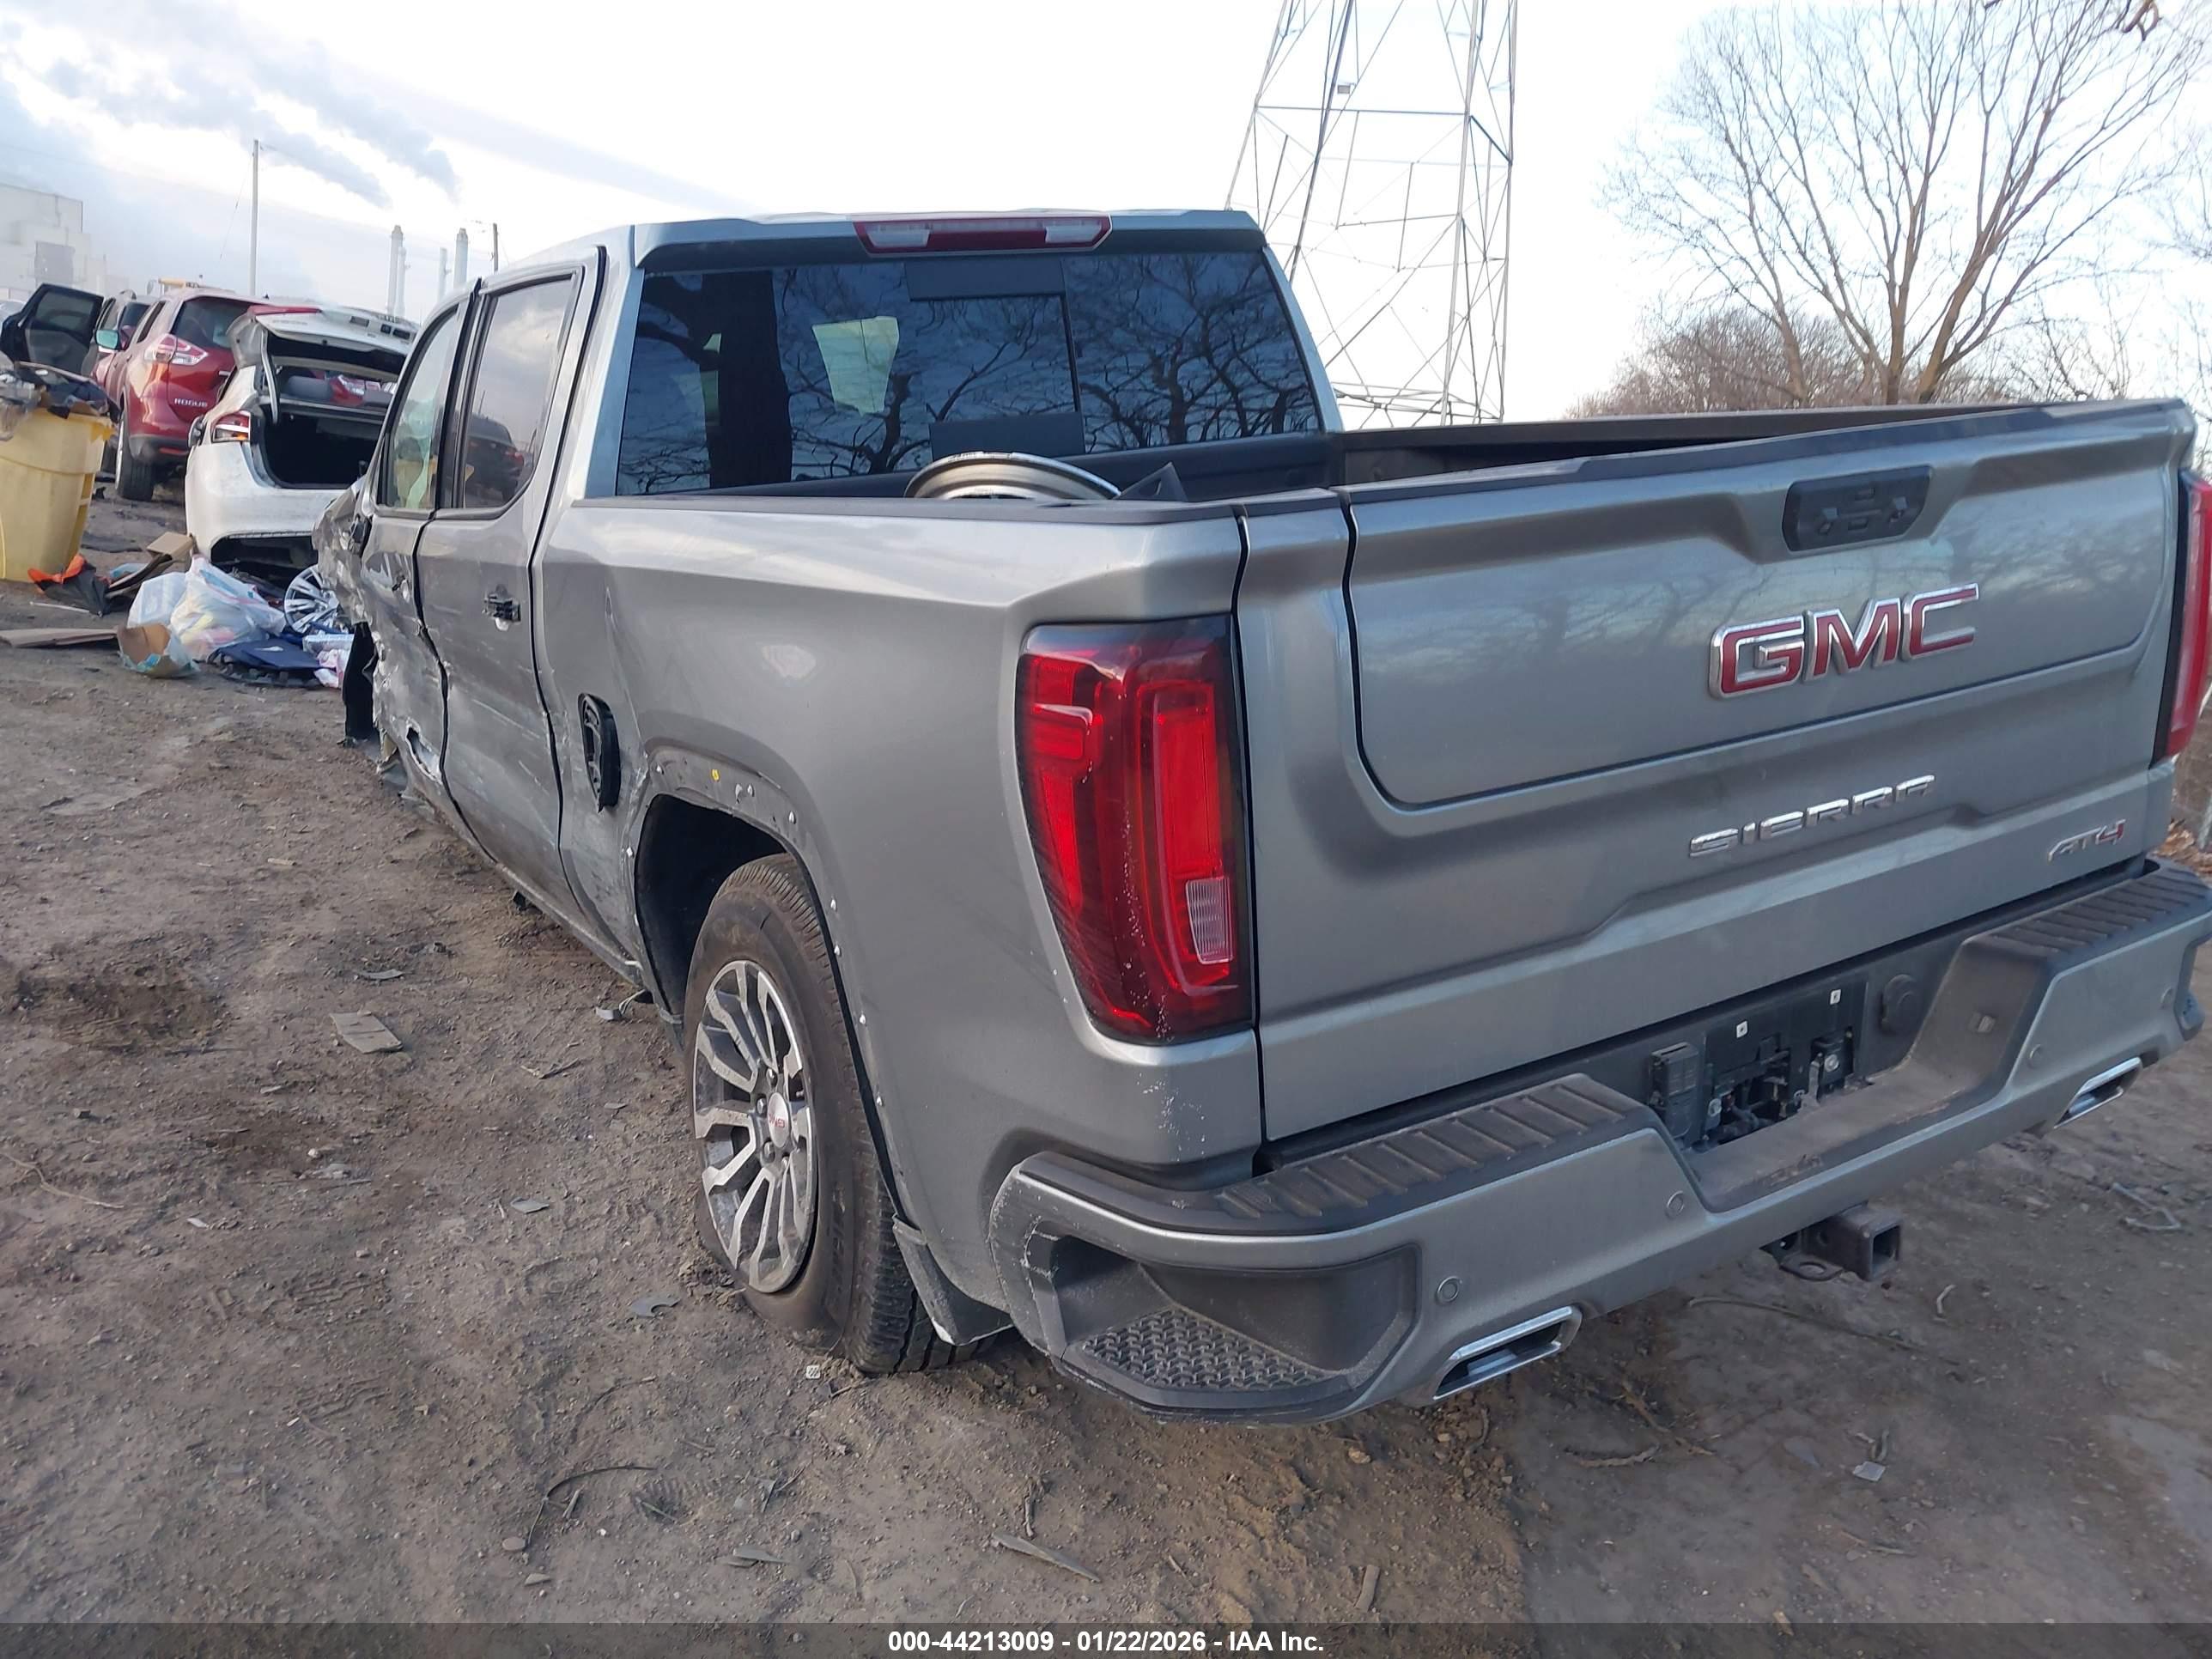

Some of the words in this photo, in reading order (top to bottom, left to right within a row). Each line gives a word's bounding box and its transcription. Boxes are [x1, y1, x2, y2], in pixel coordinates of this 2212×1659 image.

[173, 398, 208, 408] ROGUE
[1709, 583, 1979, 699] GMC
[1689, 774, 1936, 858] SIERRA
[2047, 818, 2127, 863] AT4
